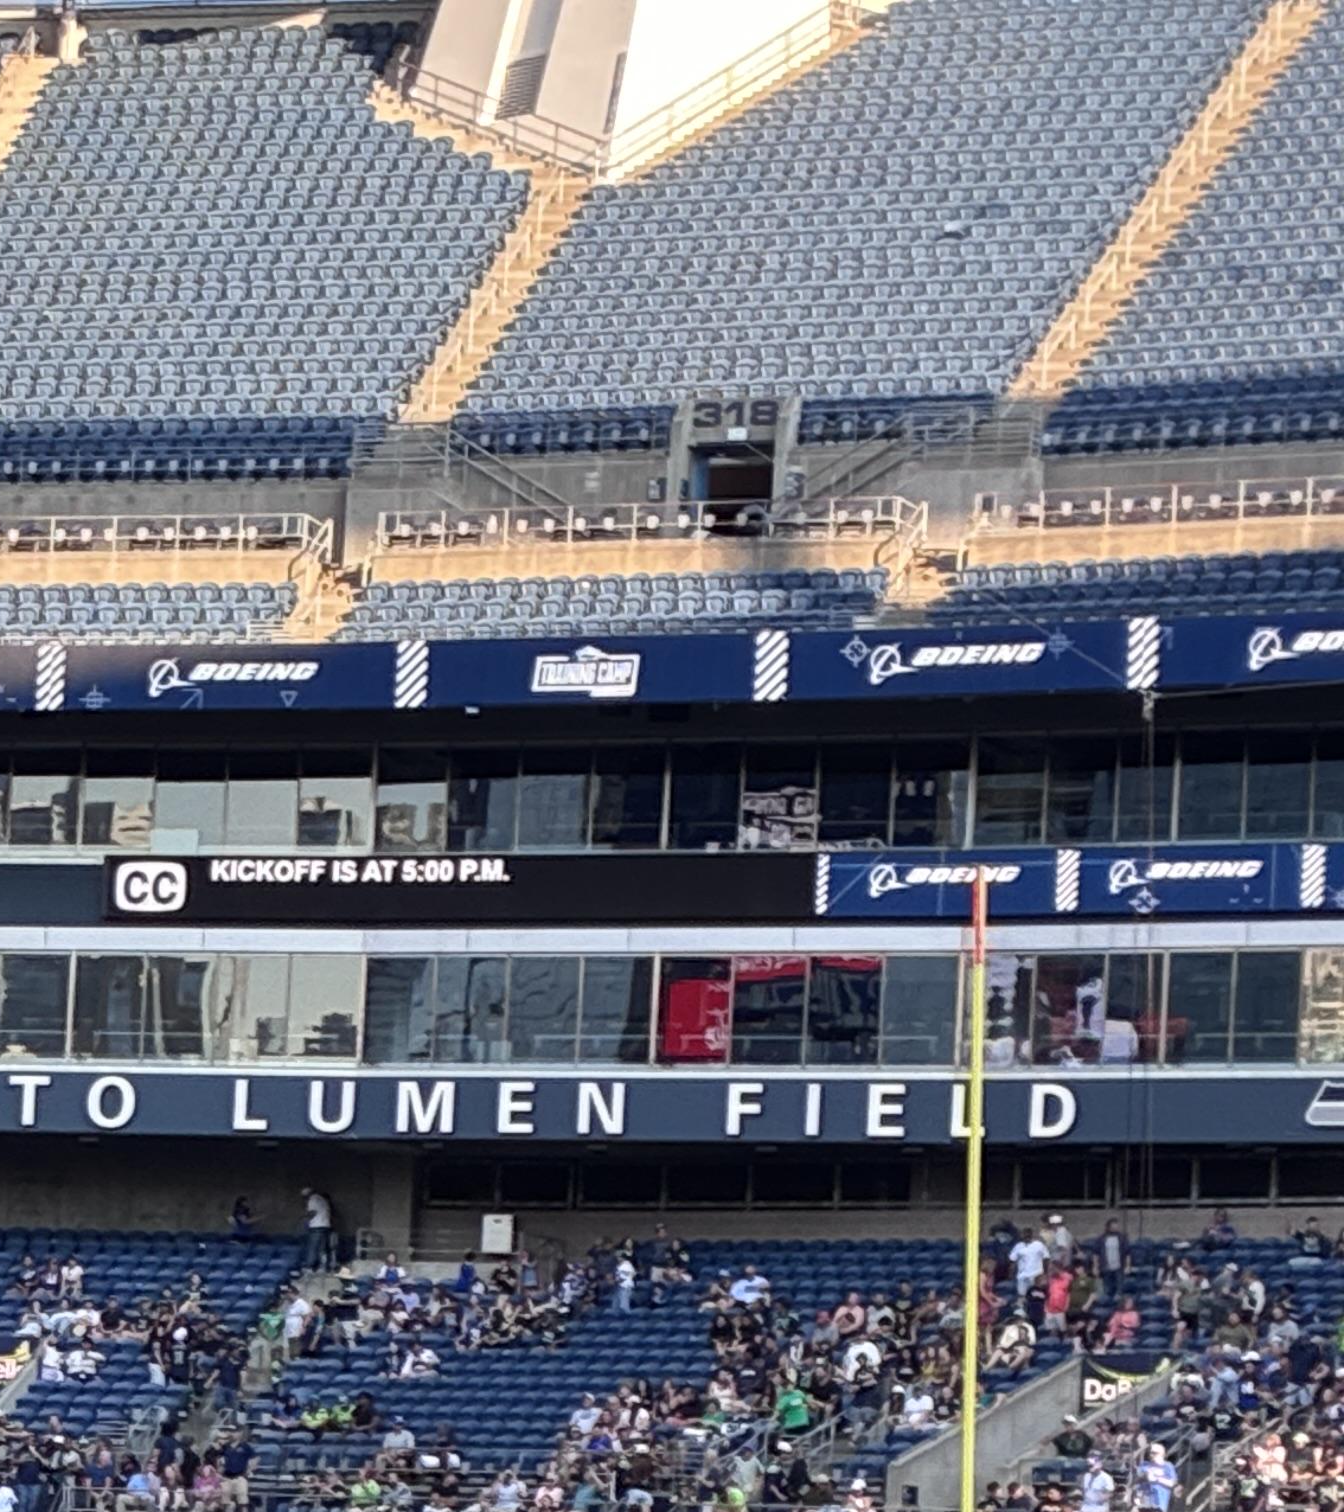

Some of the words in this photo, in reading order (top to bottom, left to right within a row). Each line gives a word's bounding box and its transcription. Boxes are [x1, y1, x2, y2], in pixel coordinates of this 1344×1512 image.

[693, 401, 779, 428] 318
[912, 641, 1046, 667] BOEING
[187, 661, 318, 682] BOEING
[541, 662, 595, 686] TRAINING
[597, 661, 633, 685] CAMP
[211, 859, 326, 882] KICKOFF
[332, 859, 359, 882] IS
[362, 859, 398, 882] AT
[401, 859, 453, 882] 5:00
[459, 858, 510, 882] P.M.
[1146, 860, 1263, 879] BOEING
[123, 870, 178, 906] CC
[11, 1073, 138, 1132] TO
[231, 1079, 629, 1137] LUMEN
[725, 1080, 1080, 1140] FIELD
